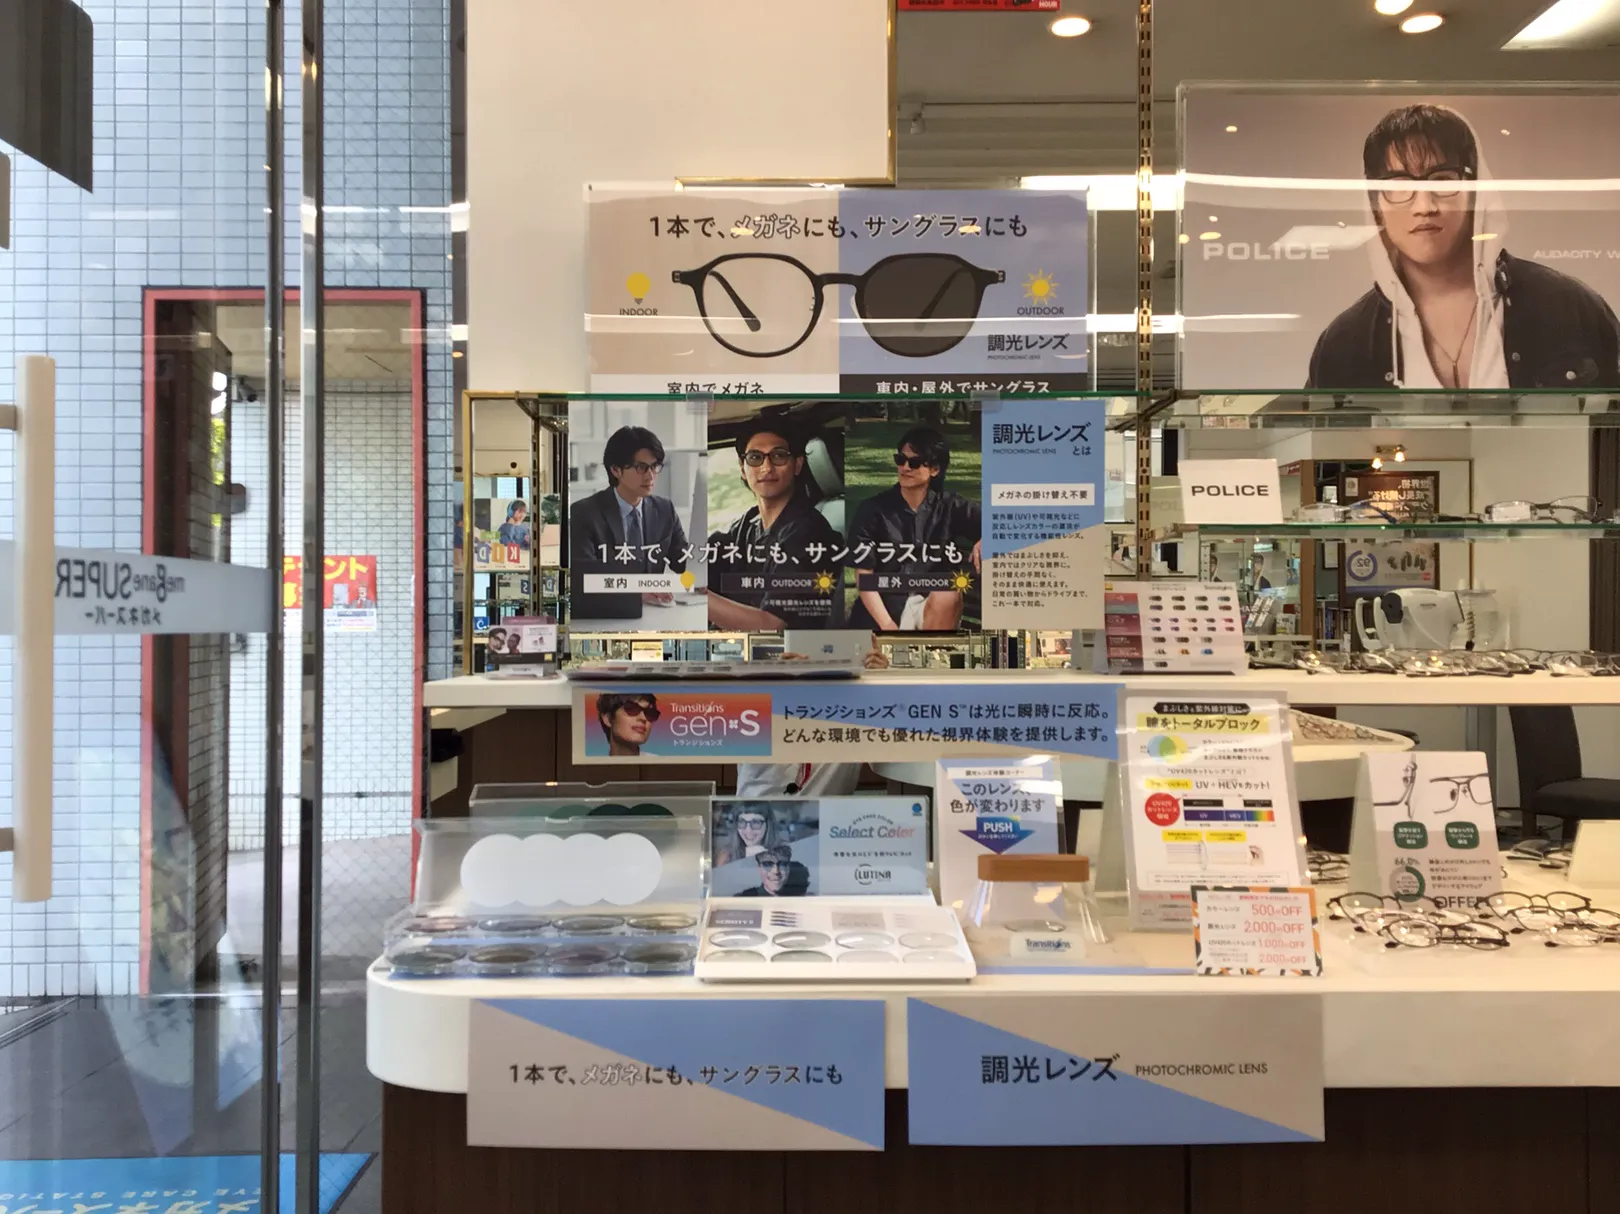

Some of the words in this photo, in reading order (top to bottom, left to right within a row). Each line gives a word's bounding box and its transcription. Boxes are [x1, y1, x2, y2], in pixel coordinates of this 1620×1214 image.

[1203, 242, 1330, 261] POLICE
[1533, 249, 1602, 259] AUDACITY
[619, 308, 658, 317] INDOOR
[1017, 306, 1064, 315] OUTDOOR
[988, 333, 1070, 351] 調光レンズ
[993, 422, 1091, 444] 調光レンズ
[1072, 446, 1091, 456] とは
[998, 490, 1088, 500] メガネの掛け替え不要
[1191, 485, 1269, 496] POLICE
[598, 541, 963, 565] 1本で、メガネにも、サングラスにも
[604, 578, 627, 589] 室内
[638, 579, 671, 588] INDOOR
[741, 576, 765, 588] 車内
[771, 578, 812, 588] OUTDOOR
[878, 576, 902, 588] 屋外
[908, 577, 950, 588] OUTDOOR
[671, 701, 724, 714] Transitions
[908, 704, 942, 719] GEN
[783, 726, 1109, 744] どんな環境でも優れた視界体験を提供します。
[950, 799, 1046, 814] 色が変わります
[829, 825, 875, 838] Select
[877, 826, 917, 838] Color
[983, 821, 1013, 833] PUSH
[509, 1063, 843, 1085] 1本で、メガネにも、サングラスにも
[981, 1053, 1121, 1084] 調光レンズ
[1135, 1063, 1235, 1077] PHOTOCHROMIC
[1239, 1062, 1268, 1075] LENS
